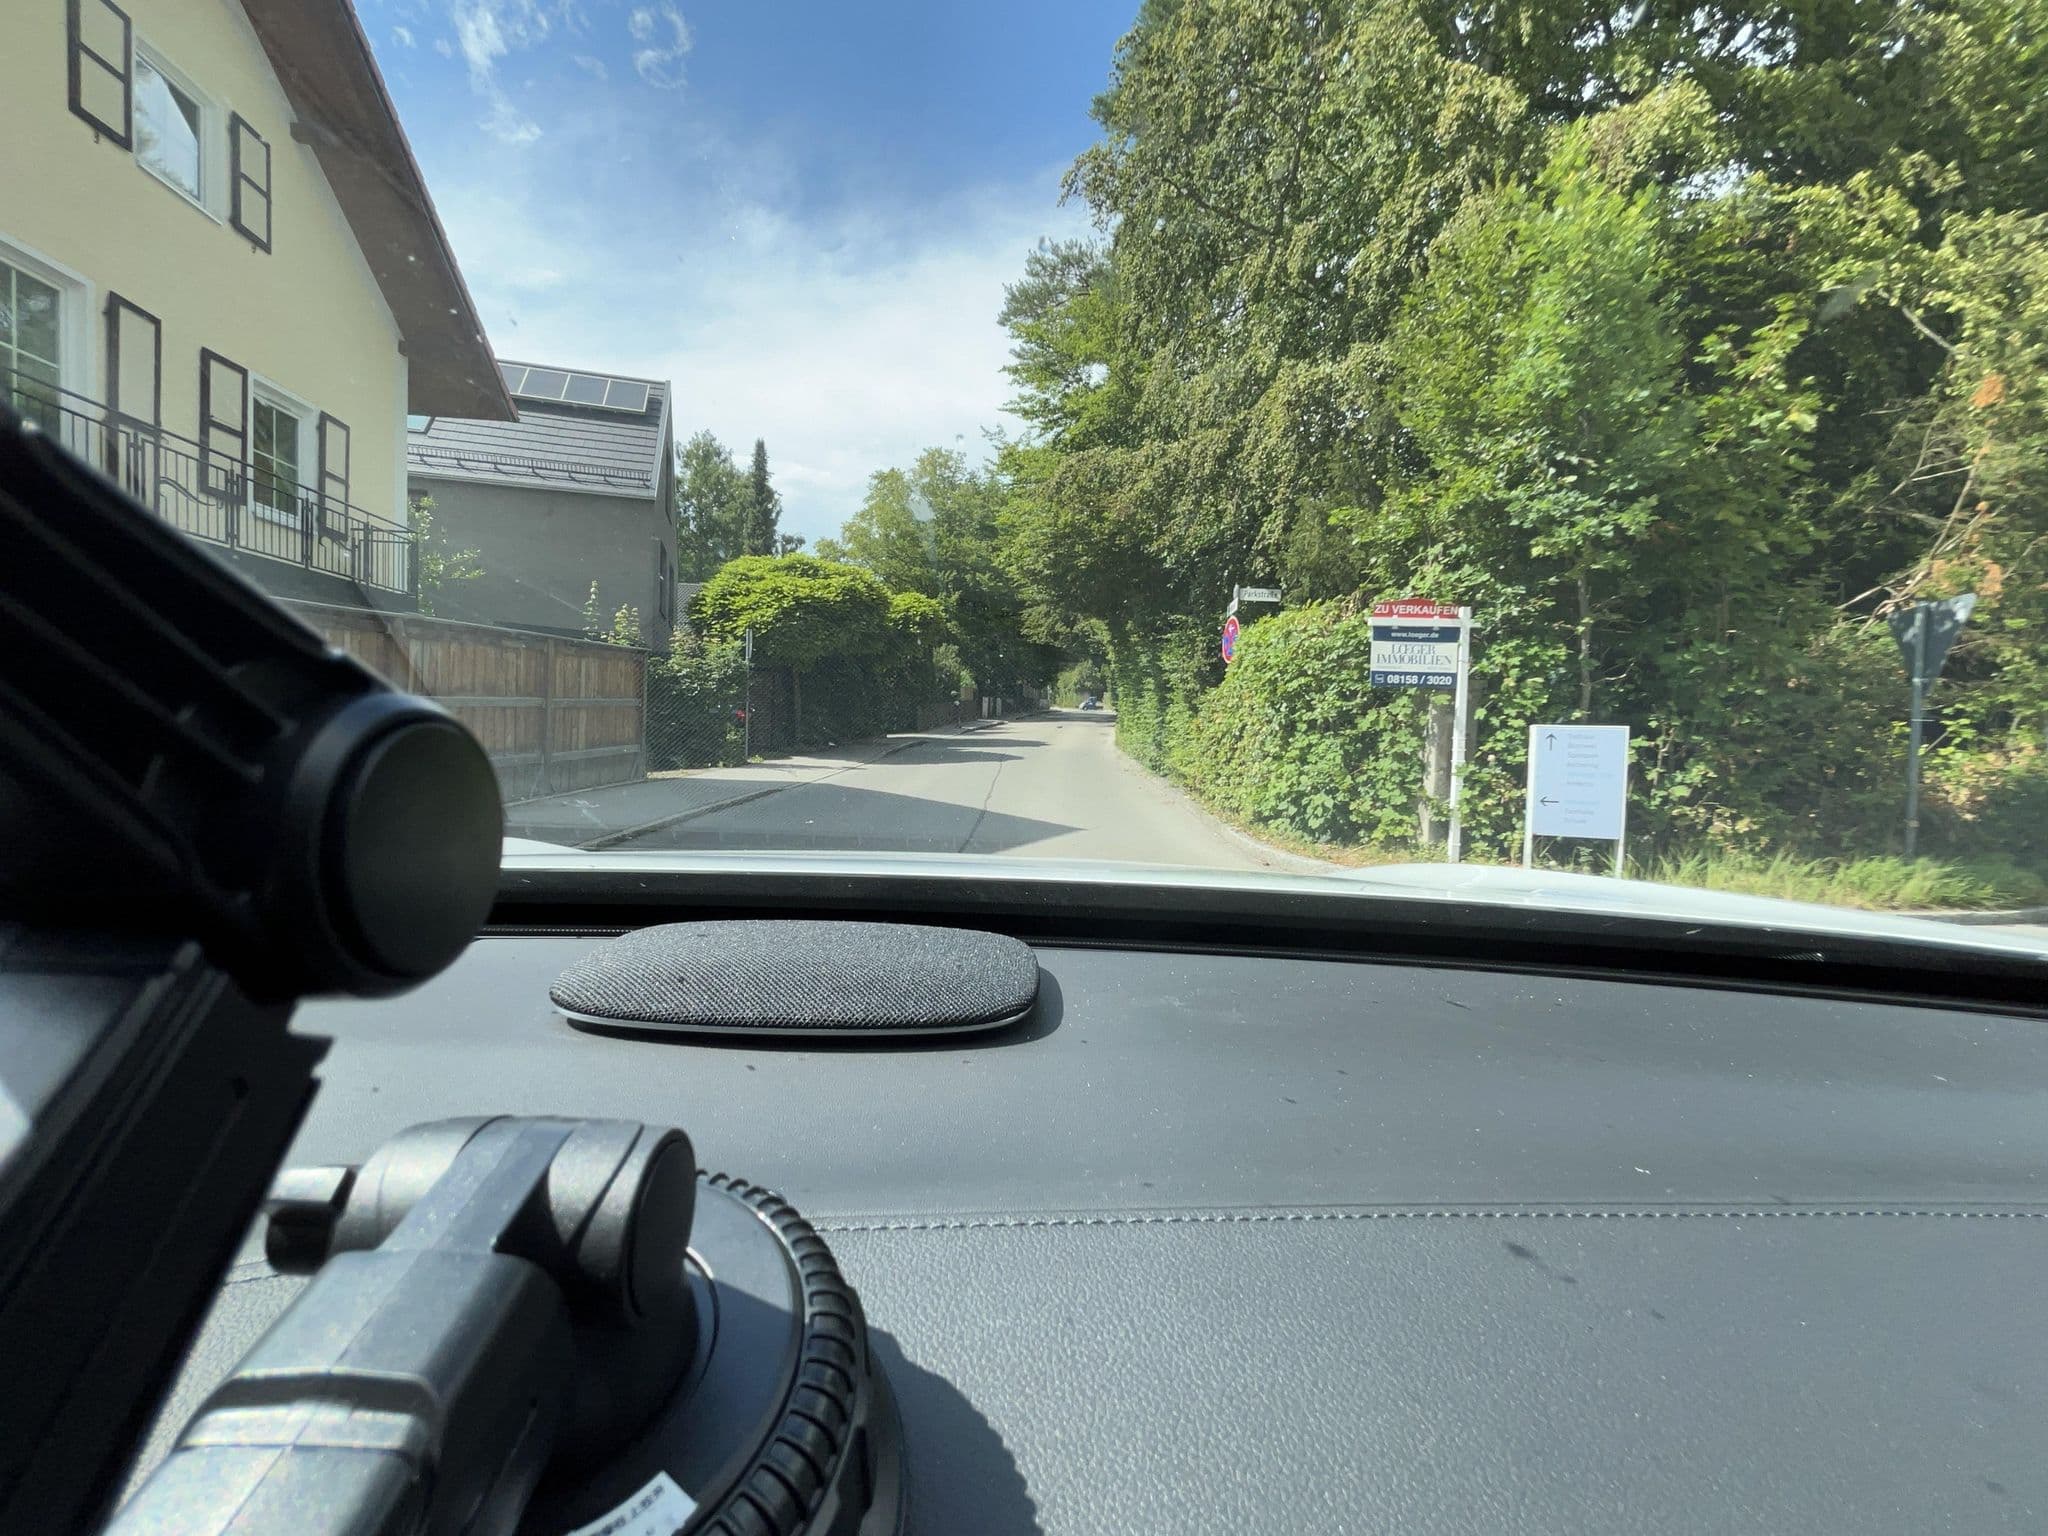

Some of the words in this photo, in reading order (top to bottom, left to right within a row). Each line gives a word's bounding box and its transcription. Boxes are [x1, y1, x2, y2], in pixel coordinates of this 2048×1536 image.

[1375, 604, 1389, 614] ZU
[1392, 604, 1459, 615] VERKAUFEN
[1376, 654, 1452, 665] IMMOBILIEN
[1387, 674, 1418, 685] 08158
[1427, 675, 1452, 685] 3020
